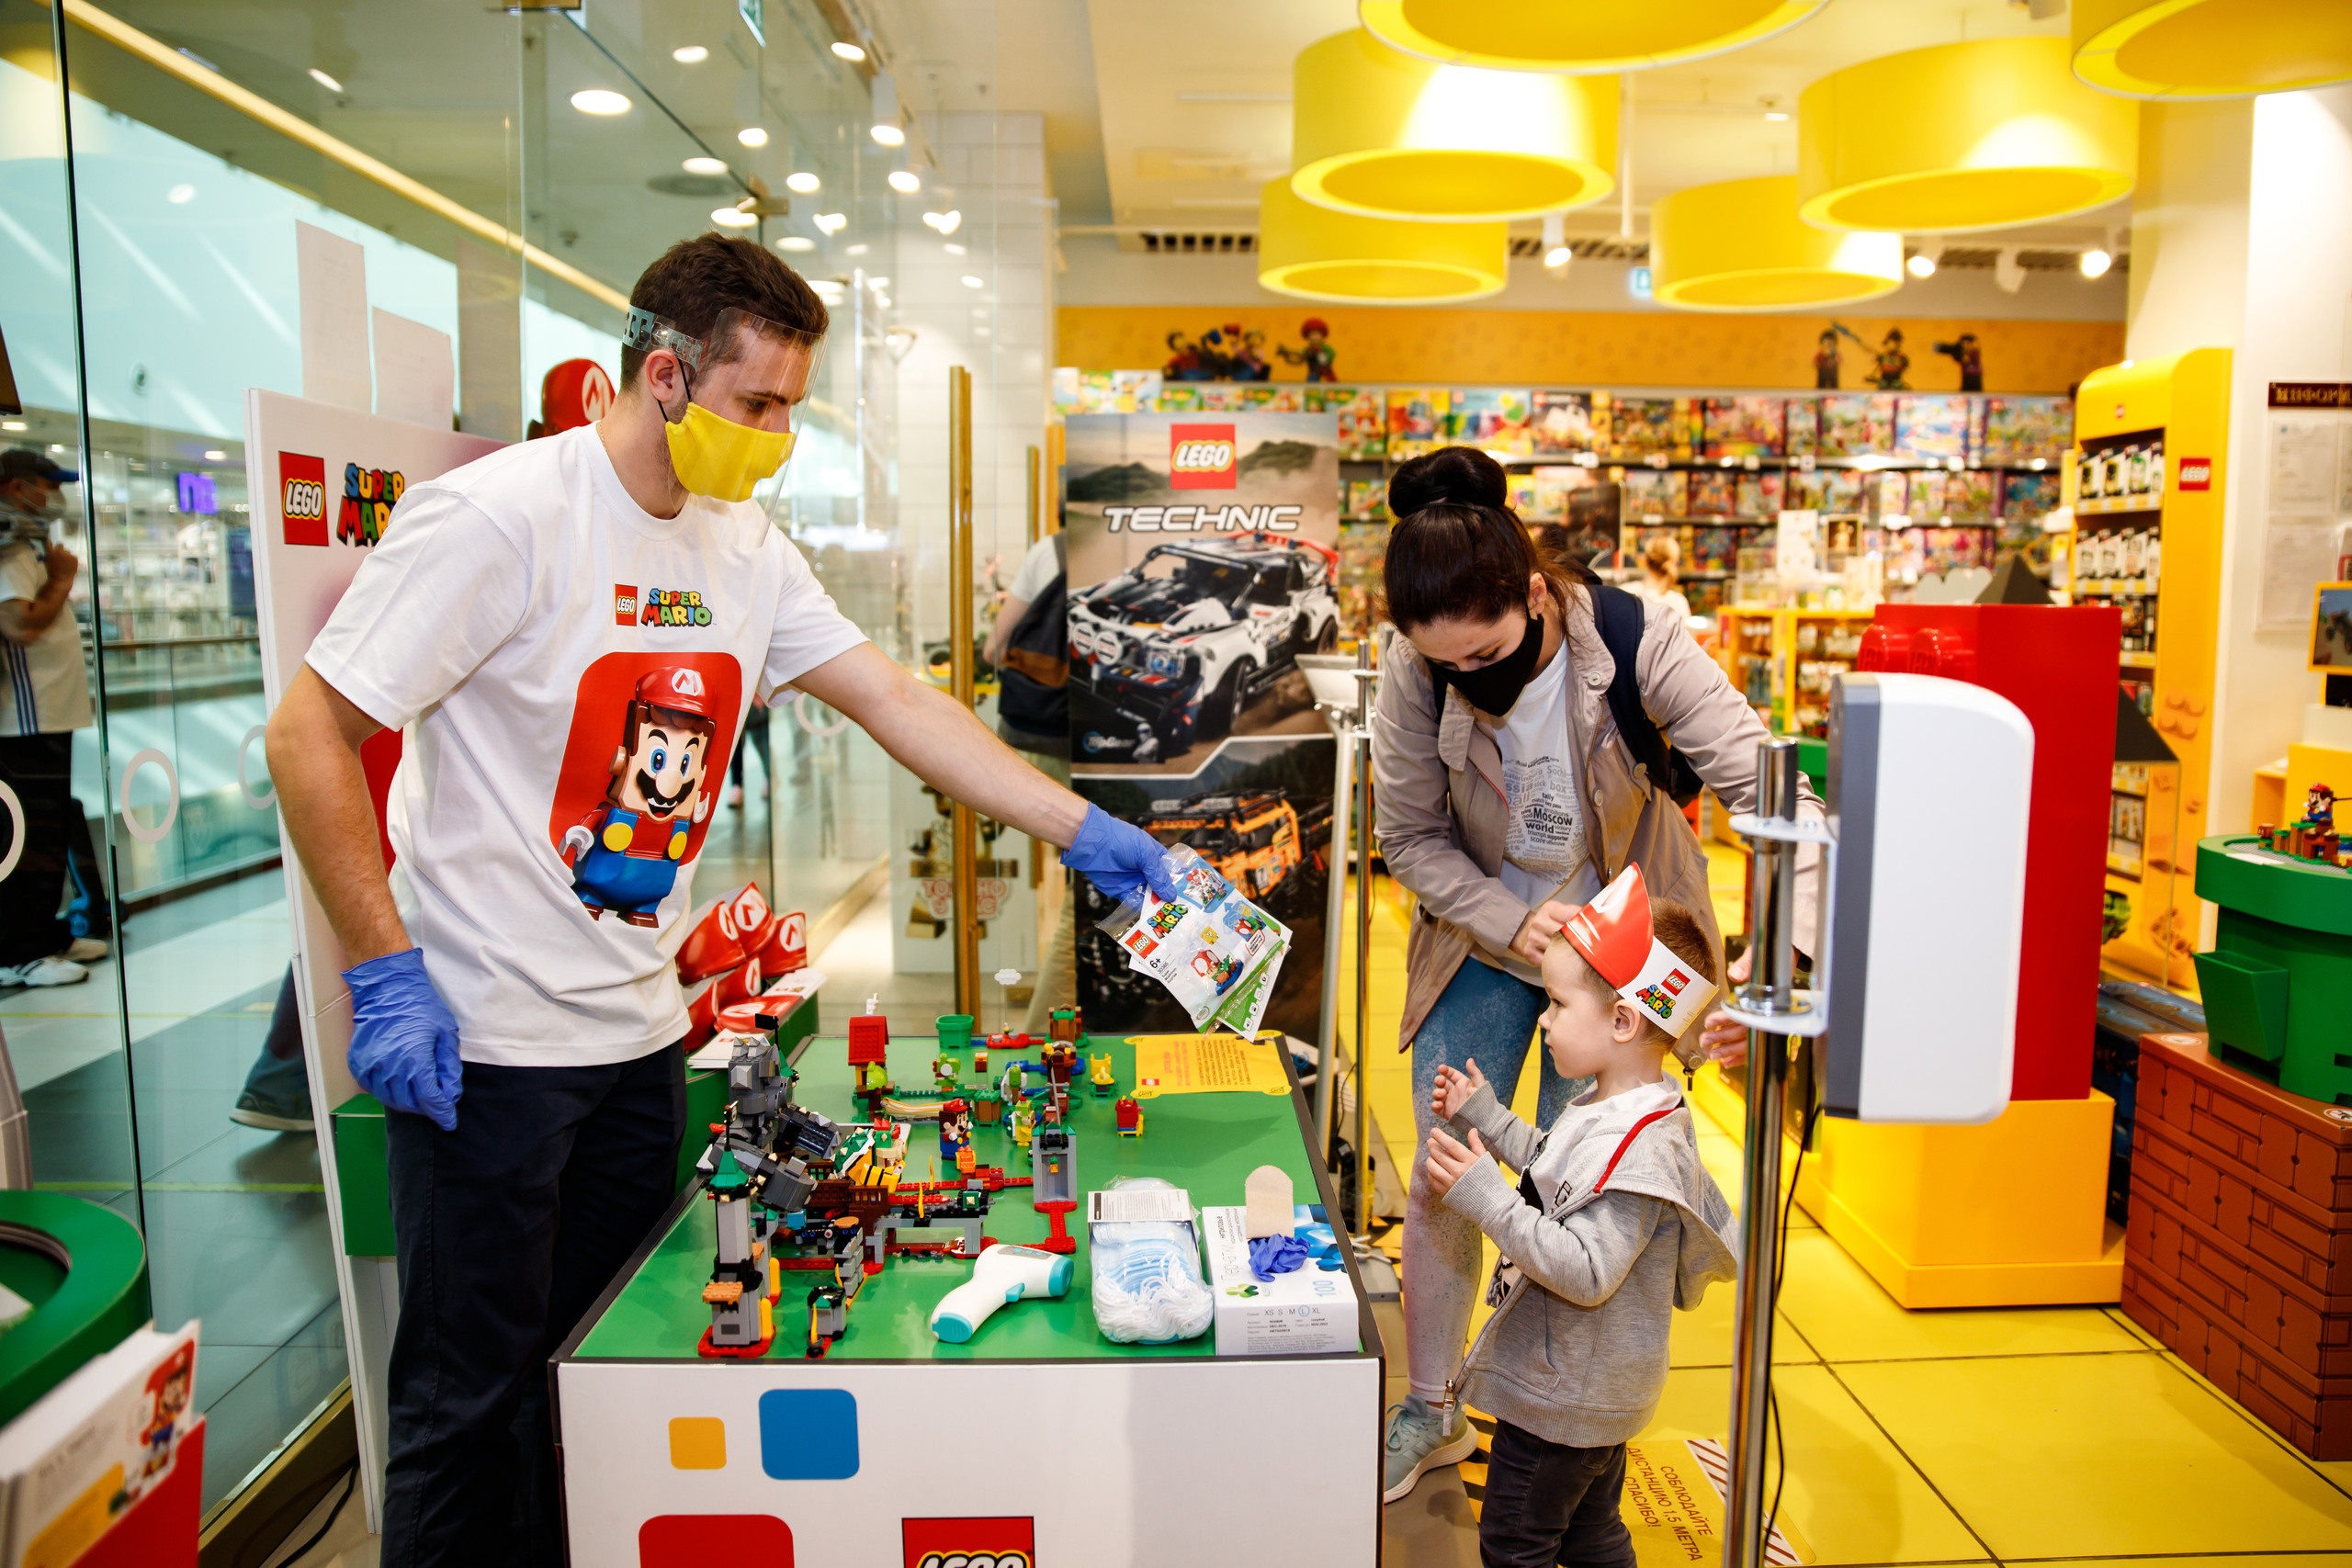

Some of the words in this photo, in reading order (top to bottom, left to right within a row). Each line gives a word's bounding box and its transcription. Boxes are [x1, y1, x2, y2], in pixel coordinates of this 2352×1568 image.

[1174, 442, 1233, 469] LEGO
[345, 462, 404, 502] SUPER
[2181, 466, 2210, 482] LEGO
[284, 479, 324, 519] LEGO
[336, 494, 397, 547] MAR
[1103, 505, 1303, 533] TECHNIC
[616, 596, 636, 614] LEGO
[649, 588, 703, 607] SUPER
[640, 603, 712, 627] MARIO
[1506, 781, 1533, 794] ssia
[1550, 780, 1566, 794] box
[1533, 807, 1573, 826] Moscow
[1525, 822, 1555, 834] world
[1527, 829, 1547, 838] triumph
[1530, 836, 1546, 844] score
[1541, 851, 1571, 861] football
[1147, 902, 1175, 928] SUPER
[1152, 904, 1188, 940] MARIO
[1132, 935, 1150, 953] LEGO
[1149, 957, 1161, 969] 6+
[1668, 975, 1685, 989] LEGO
[1635, 987, 1672, 1020] MARIO
[1648, 984, 1676, 1010] SUPER
[1312, 1280, 1337, 1297] 100
[1623, 1475, 1661, 1528] СПАСИБО!
[1626, 1447, 1672, 1507] ДИСТАНЦИЮ
[1663, 1509, 1681, 1524] 1,5
[1672, 1525, 1703, 1561] МЕТРА
[1660, 1465, 1713, 1536] СОБЛЮДАЙТЕ
